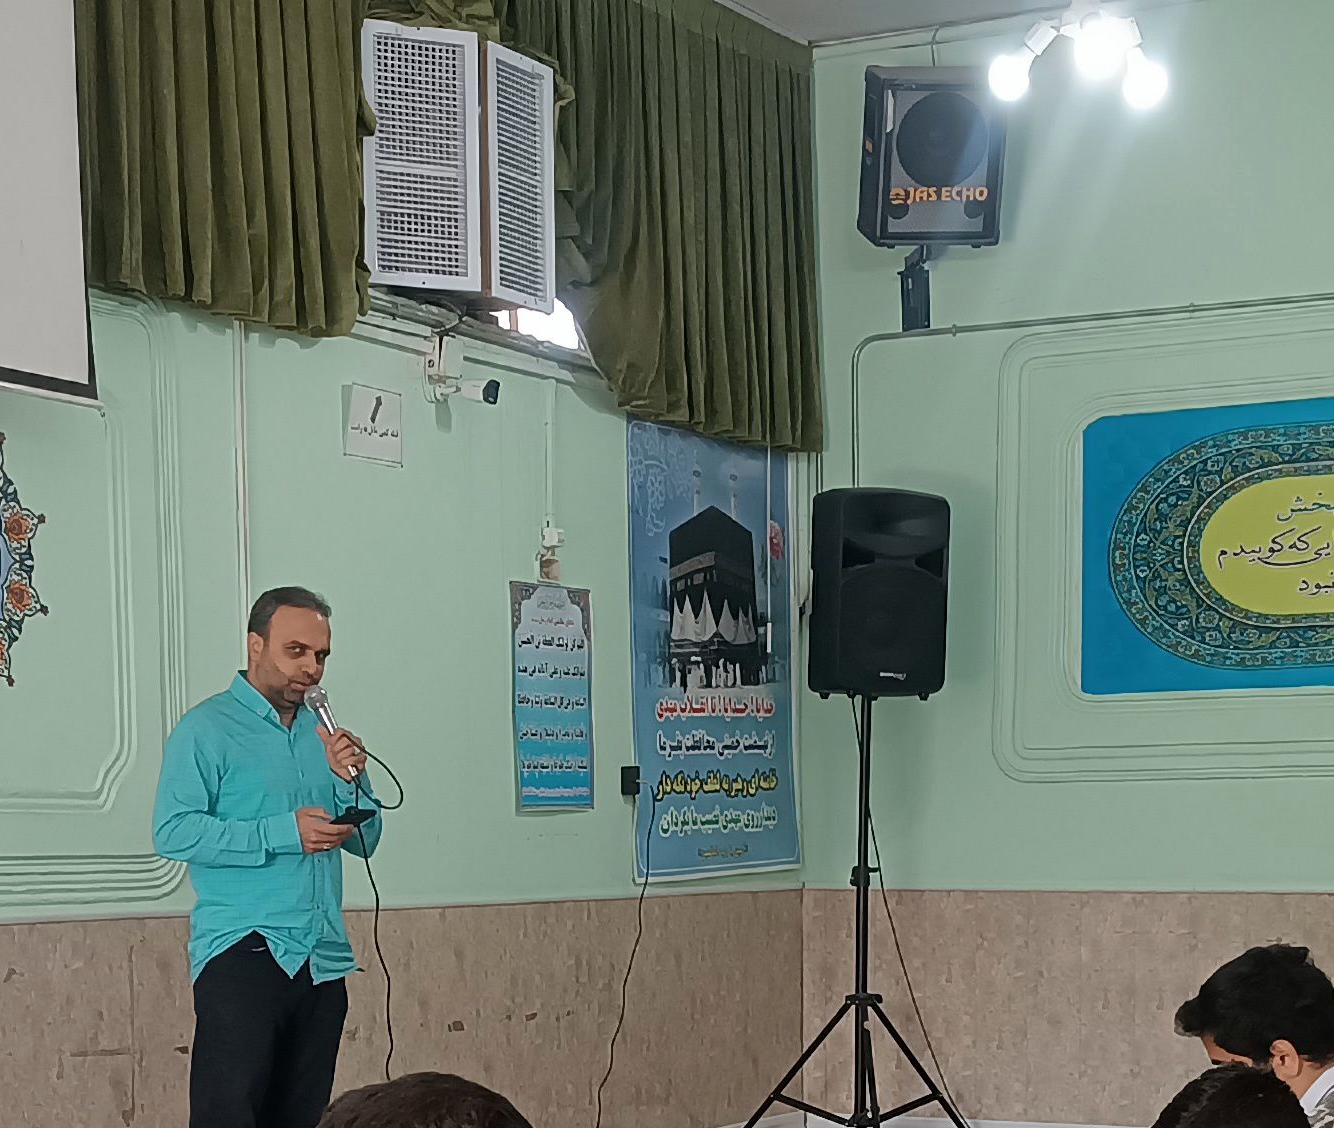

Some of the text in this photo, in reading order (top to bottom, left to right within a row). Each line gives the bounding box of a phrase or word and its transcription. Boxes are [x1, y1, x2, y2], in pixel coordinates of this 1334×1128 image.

[907, 186, 988, 204] JAS ECHO
[1288, 525, 1323, 551] که
